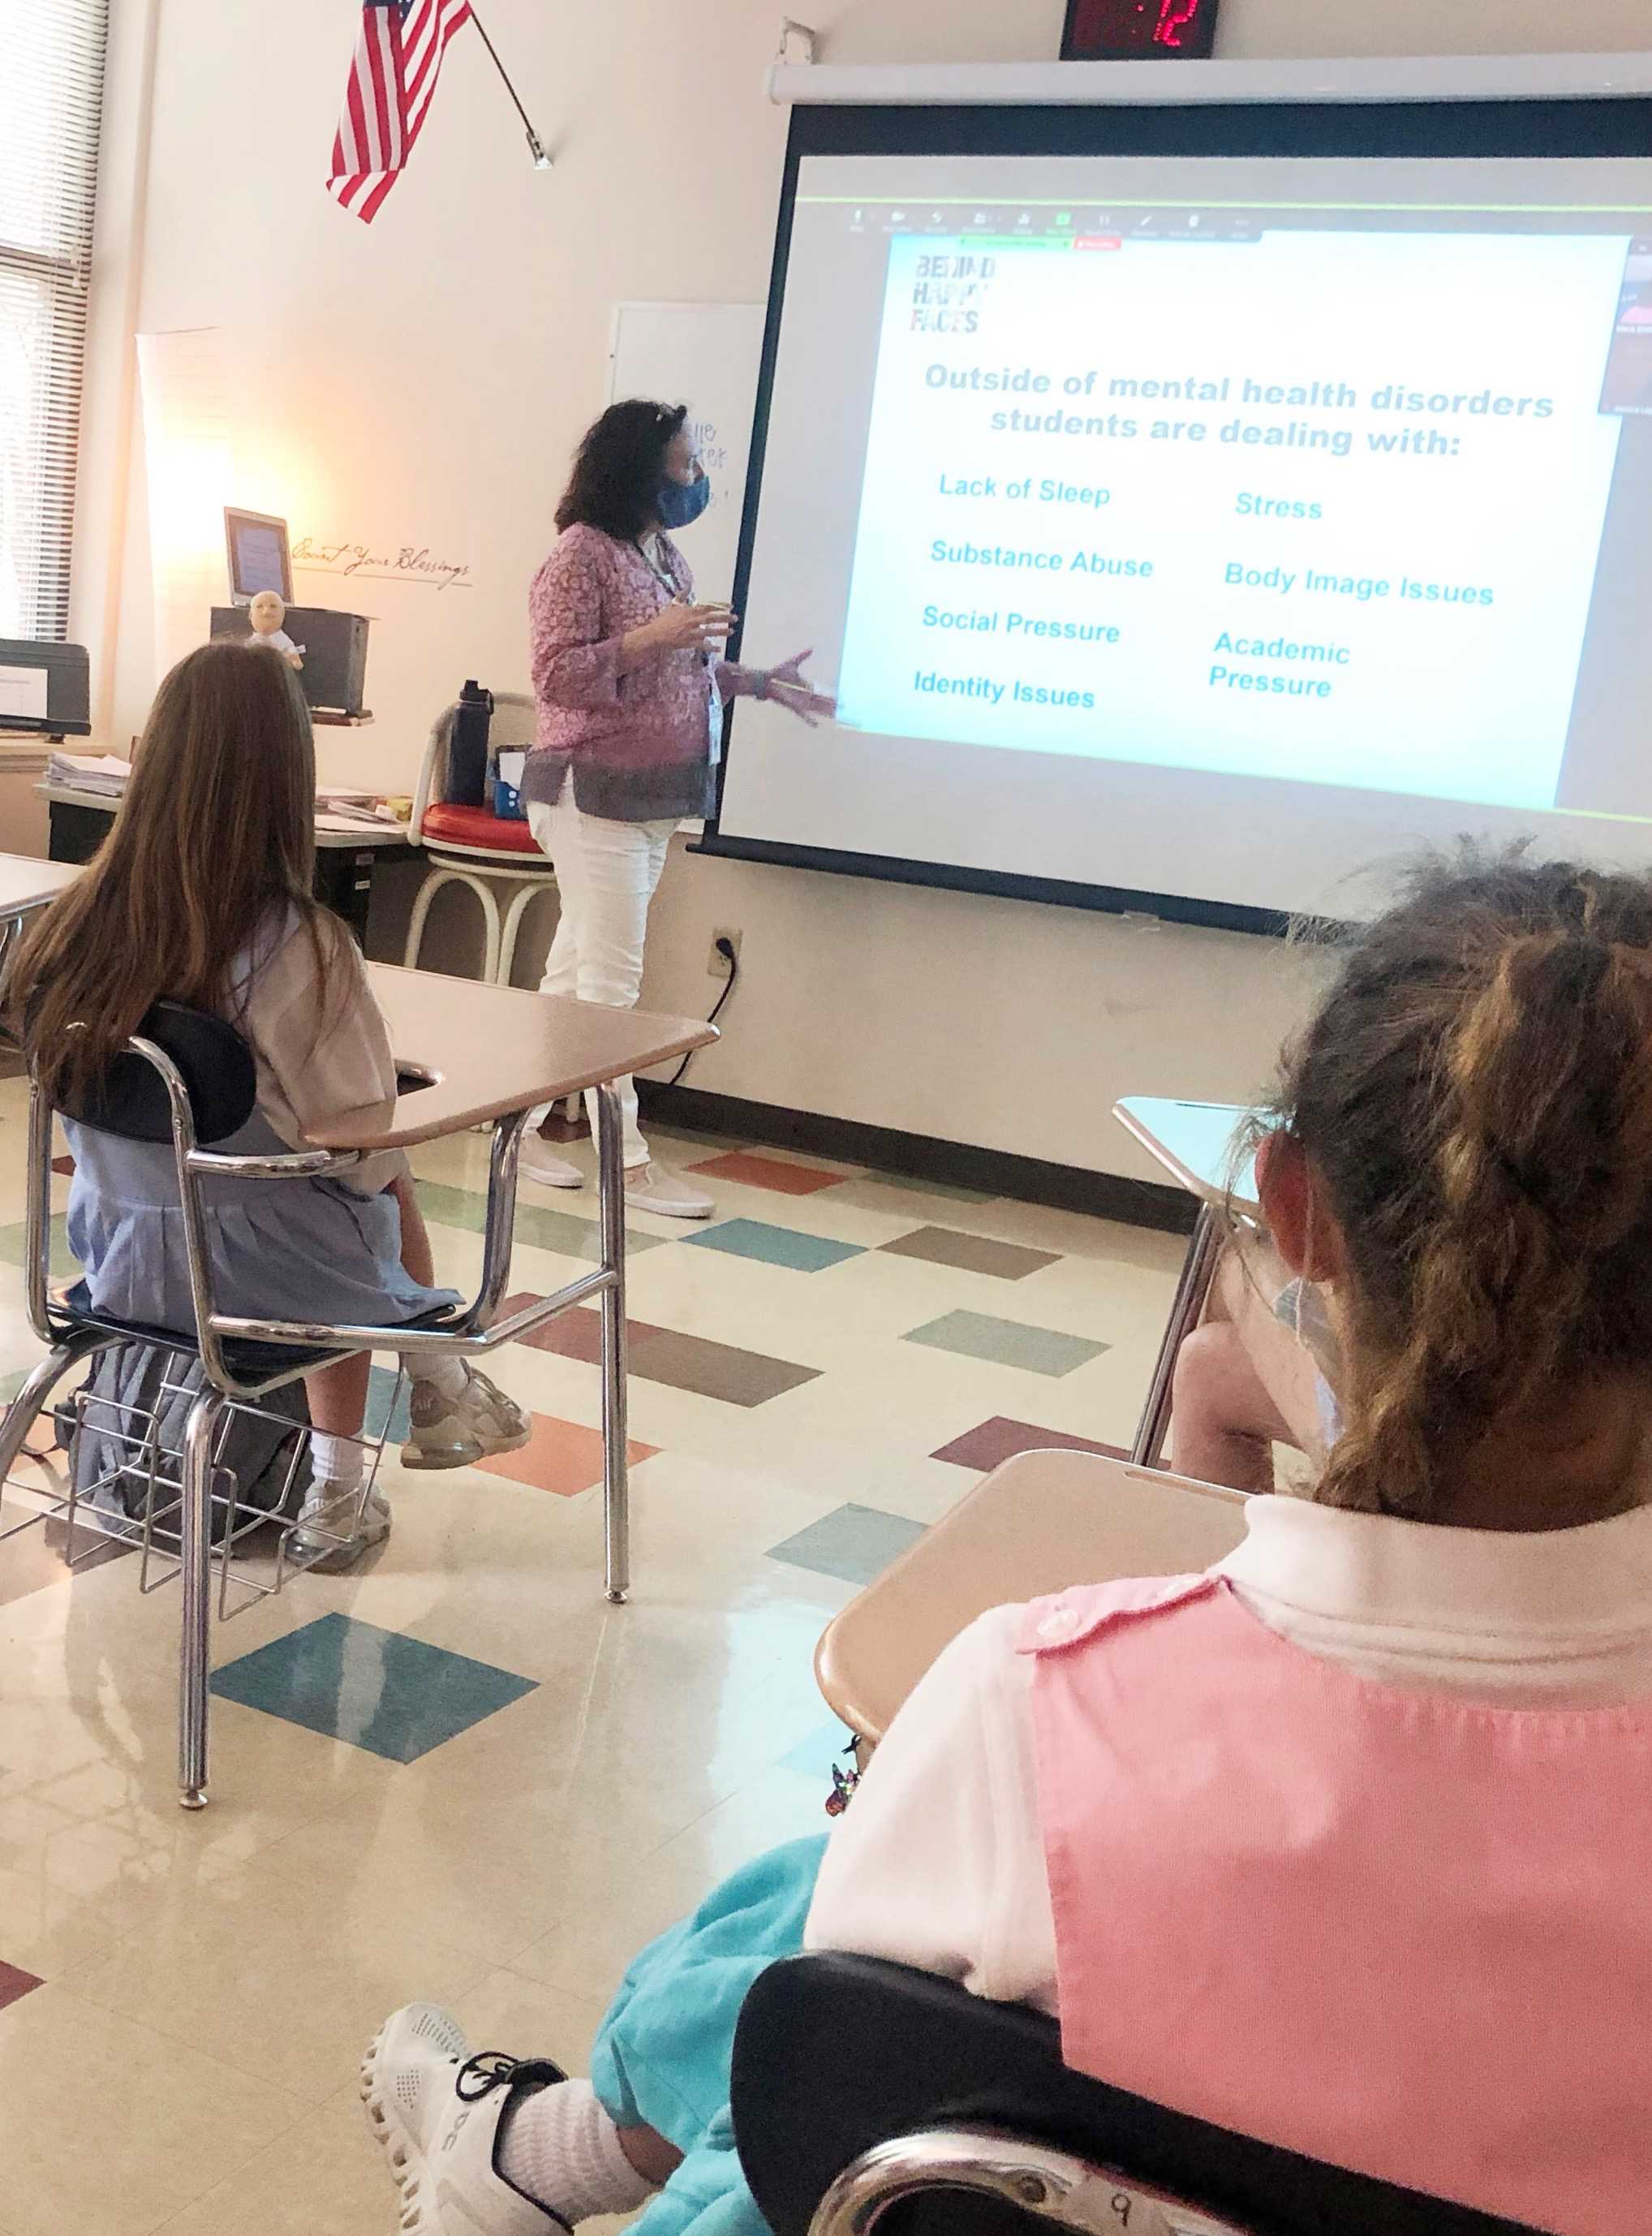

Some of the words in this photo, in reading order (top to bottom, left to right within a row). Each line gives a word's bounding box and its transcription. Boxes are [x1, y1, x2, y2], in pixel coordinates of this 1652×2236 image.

[925, 364, 1050, 394] Outside
[1064, 371, 1097, 394] of
[1109, 377, 1229, 401] mental
[1242, 378, 1356, 407] health
[1371, 386, 1553, 417] disorders
[991, 409, 1138, 437] students
[1151, 420, 1206, 441] are
[1220, 419, 1353, 456] dealing
[1367, 429, 1460, 455] with:
[940, 474, 996, 496] Lack
[1006, 479, 1031, 498] of
[1039, 480, 1110, 508] Sleep
[1236, 493, 1322, 519] Stress
[394, 548, 470, 591] Blessings
[931, 540, 1062, 571] Substance
[1070, 551, 1152, 576] Abuse
[1225, 562, 1296, 593] Body
[1306, 571, 1389, 601] Image
[1400, 578, 1493, 605] Issues
[923, 605, 998, 631] Social
[1006, 613, 1120, 643] Pressure
[1214, 632, 1349, 664] Academic
[914, 671, 1005, 704] Identity
[1013, 681, 1094, 708] Issues
[1209, 666, 1331, 697] Pressure
